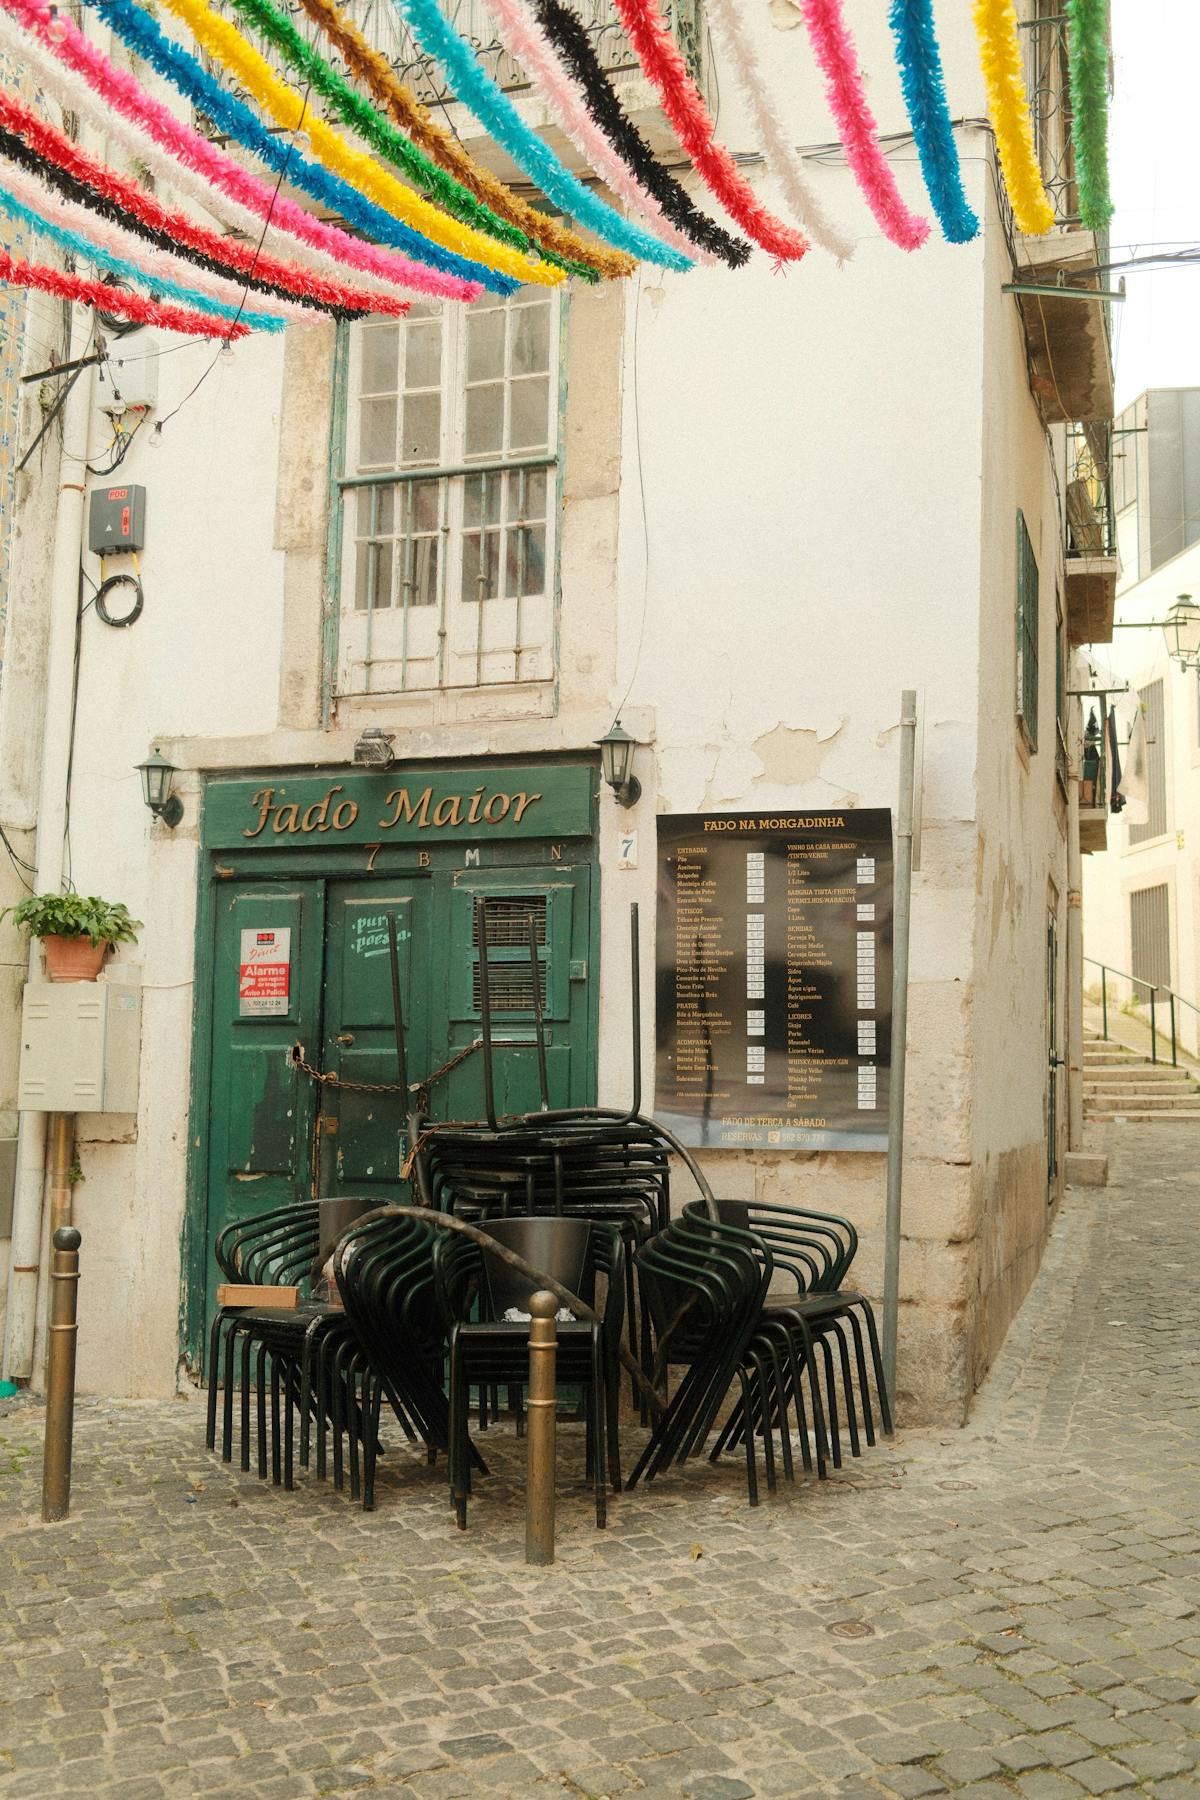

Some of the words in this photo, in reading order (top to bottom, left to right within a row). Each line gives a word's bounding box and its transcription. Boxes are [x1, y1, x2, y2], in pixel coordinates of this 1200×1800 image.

[243, 785, 359, 838] Fado
[379, 785, 542, 828] Maior
[704, 820, 737, 831] FADO
[739, 819, 757, 830] NA
[759, 817, 845, 829] MORGADINHA
[363, 844, 381, 871] 7
[418, 851, 431, 868] B
[464, 848, 480, 867] M
[550, 845, 562, 860] N
[621, 839, 633, 858] 7
[356, 930, 407, 953] poesa
[244, 966, 286, 976] Alarme
[722, 1117, 743, 1126] FADO
[744, 1117, 756, 1127] DE
[785, 1118, 792, 1127] A
